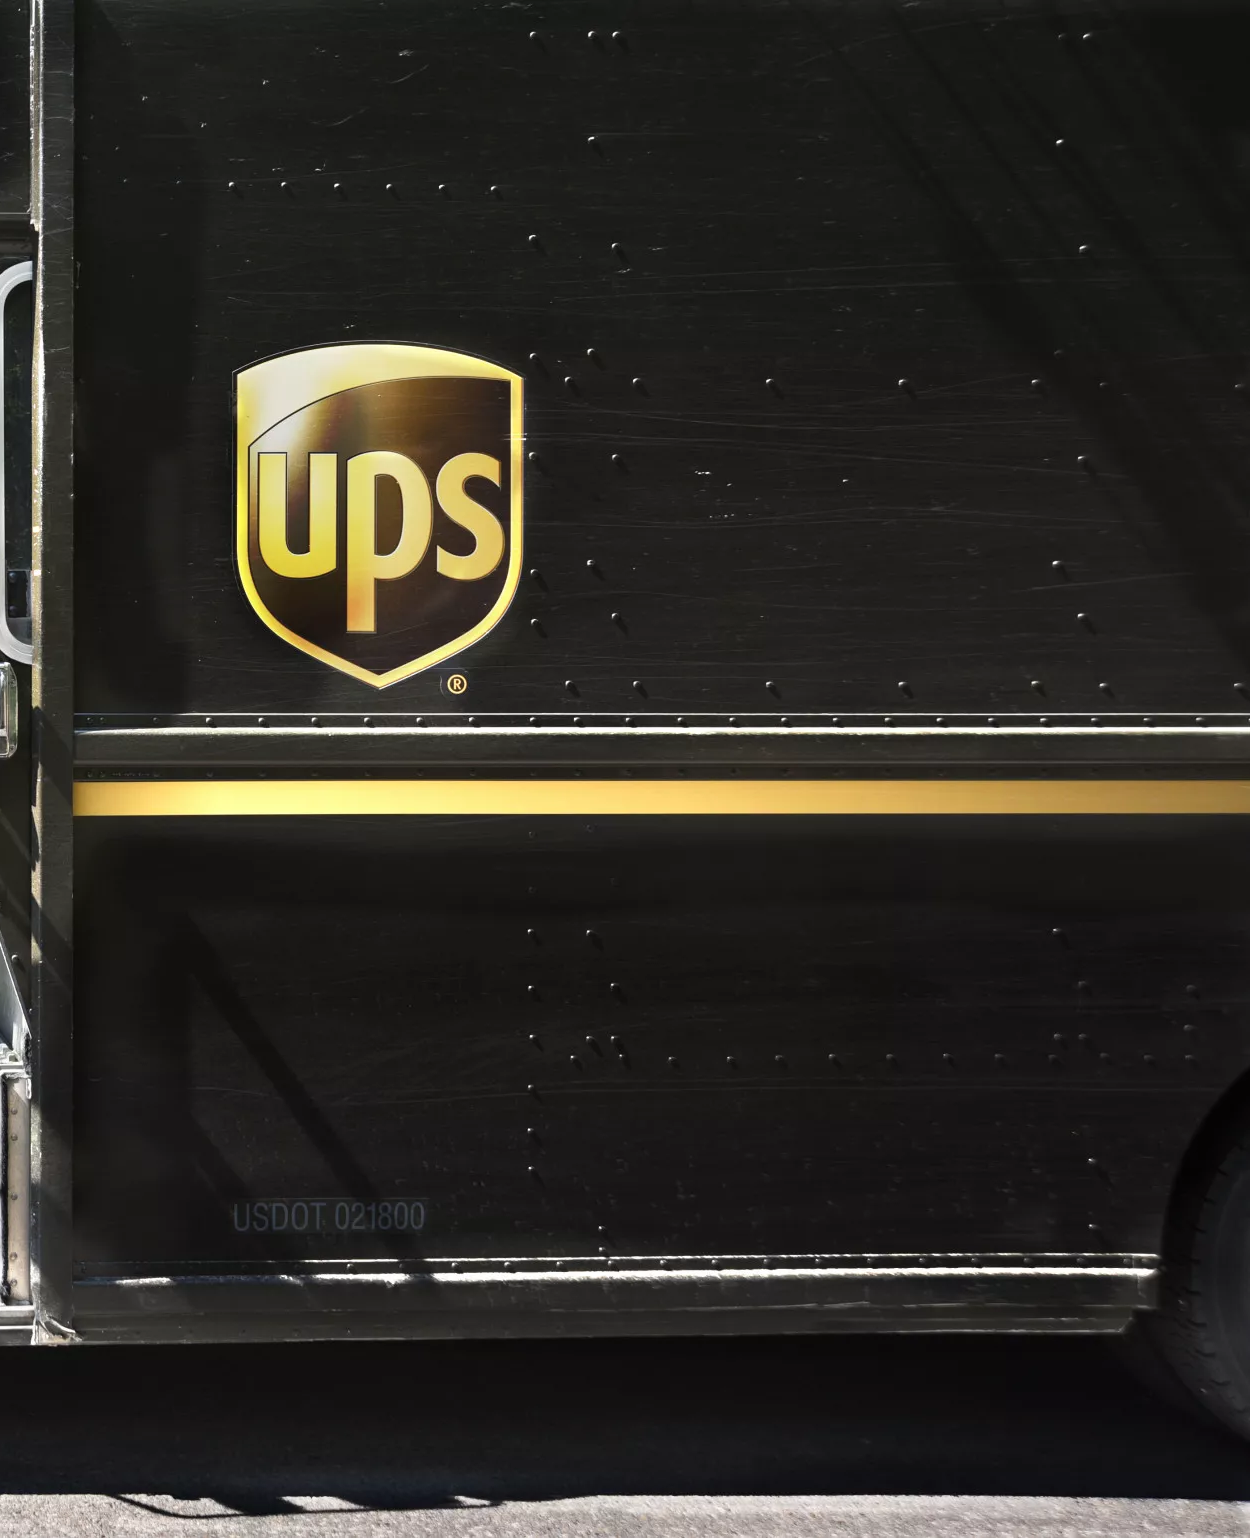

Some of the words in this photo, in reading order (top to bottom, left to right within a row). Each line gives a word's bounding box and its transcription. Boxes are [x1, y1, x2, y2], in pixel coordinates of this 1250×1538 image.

[257, 451, 505, 633] ups
[233, 1203, 327, 1231] USDOT
[335, 1203, 425, 1230] 021800
